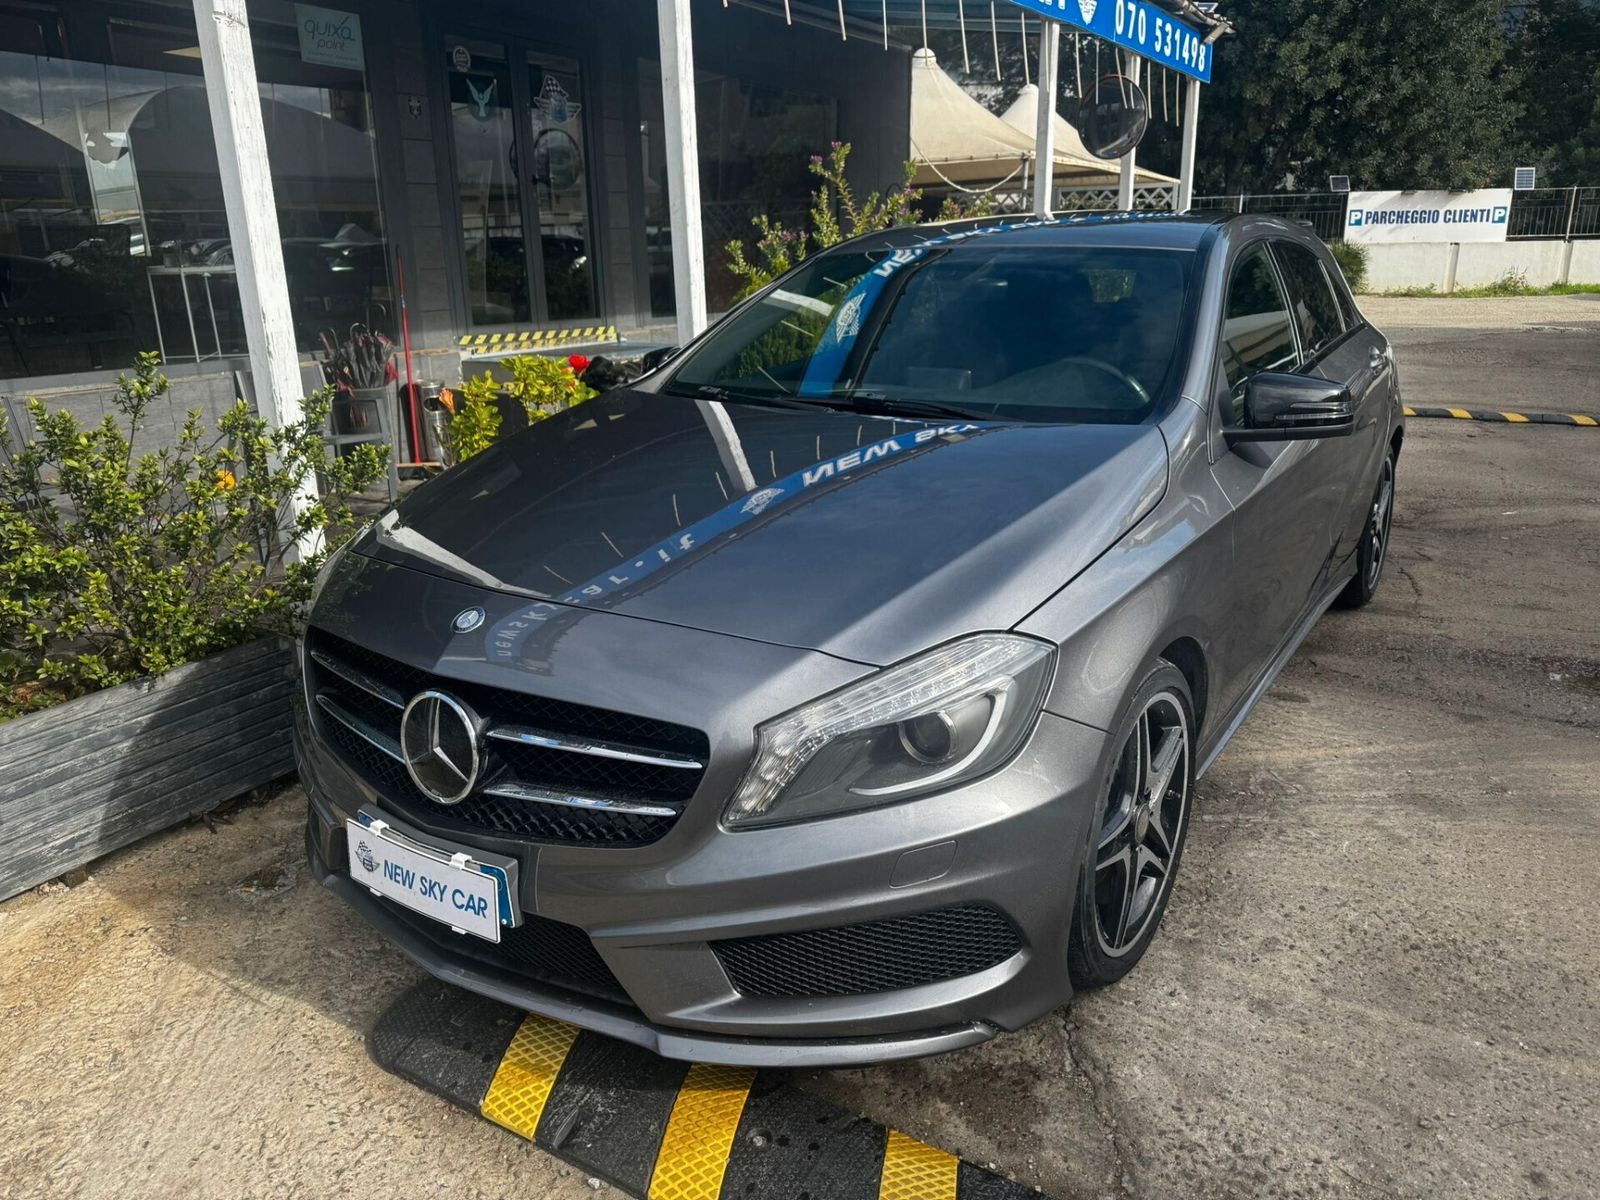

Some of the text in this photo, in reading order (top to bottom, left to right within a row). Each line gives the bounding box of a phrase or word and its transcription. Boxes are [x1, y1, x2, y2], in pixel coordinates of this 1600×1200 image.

[317, 38, 345, 52] point
[1115, 0, 1147, 45] 070
[1154, 17, 1206, 73] 531498
[1364, 209, 1440, 225] PARCHEGGIO
[1443, 208, 1491, 223] CLIENTI
[383, 859, 416, 890] NEW
[420, 876, 448, 903] SKY
[452, 889, 489, 919] CAR
